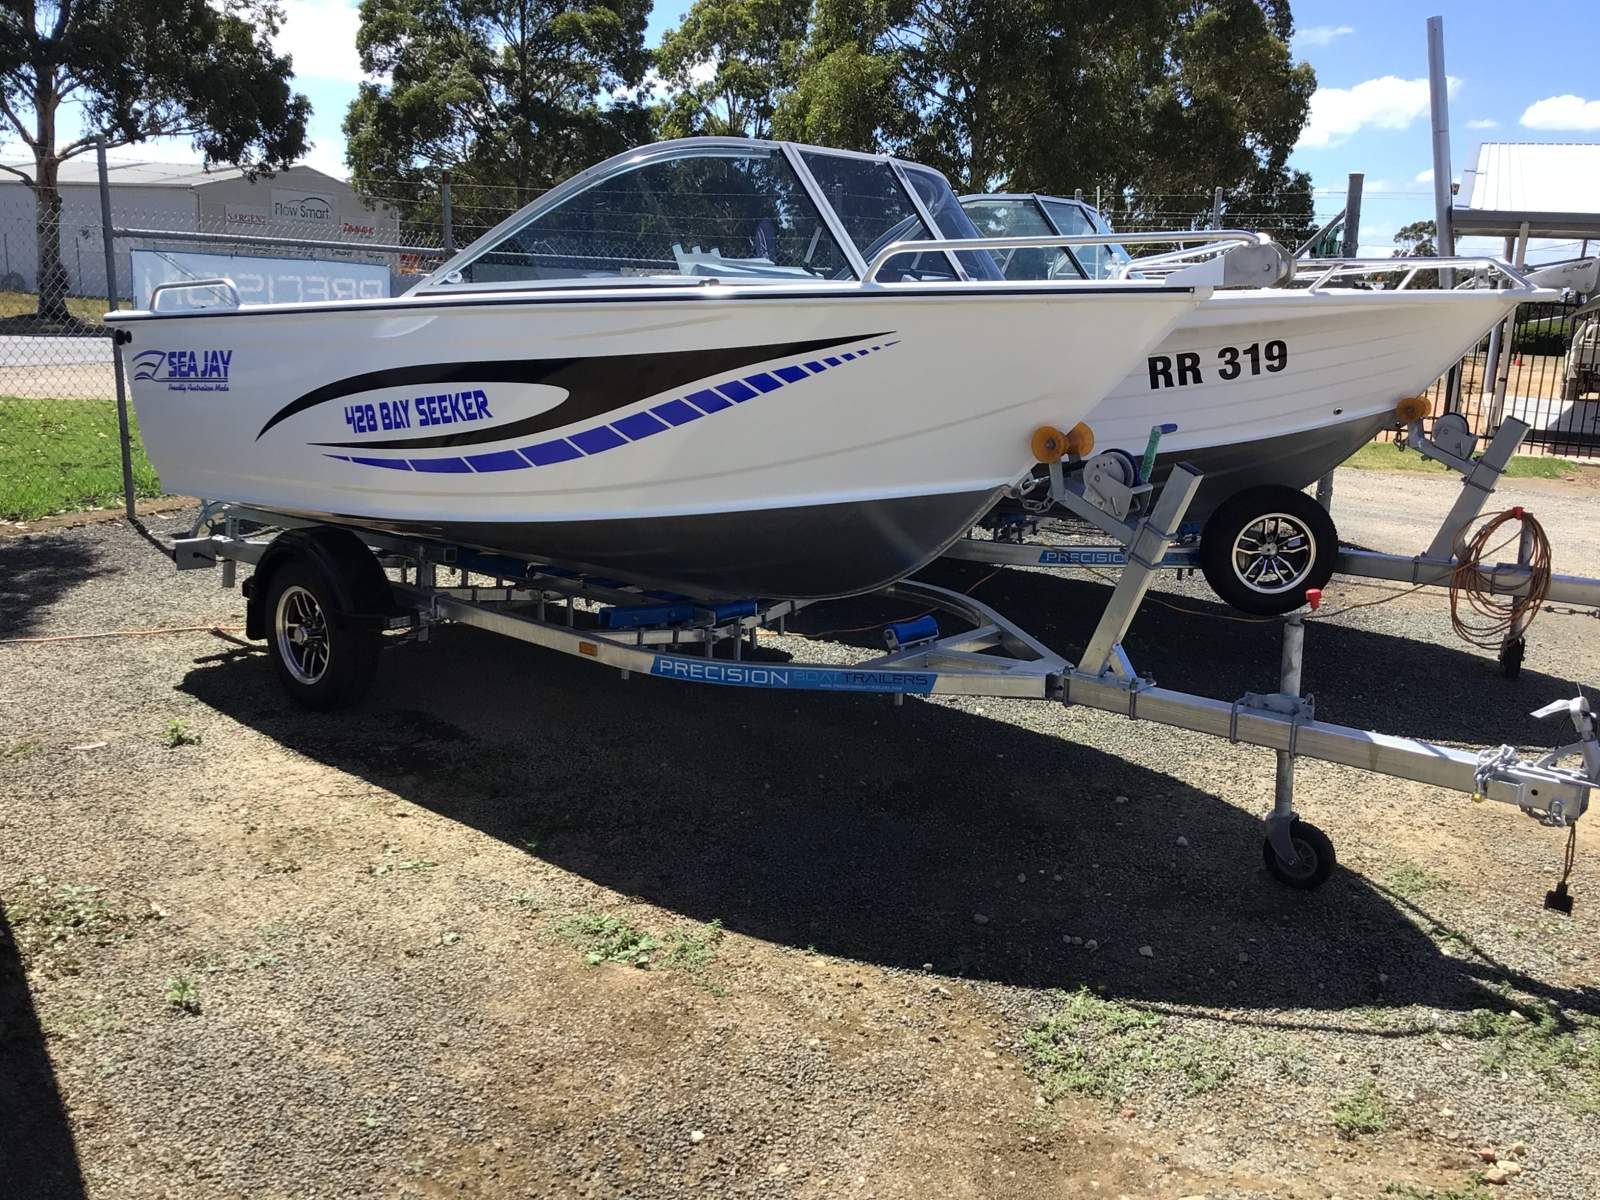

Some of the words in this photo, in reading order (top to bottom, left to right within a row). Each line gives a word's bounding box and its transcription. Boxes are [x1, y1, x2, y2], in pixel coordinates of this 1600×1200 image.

[274, 202, 298, 217] Flow
[300, 204, 330, 220] Smart
[1147, 351, 1204, 390] RR
[1217, 339, 1288, 381] 319
[344, 404, 378, 434] 428
[379, 399, 411, 431] BAY
[415, 389, 494, 427] SEEKER
[1046, 551, 1125, 564] PRECISIO
[659, 659, 789, 685] PRECISION
[793, 671, 841, 681] BOAT
[842, 672, 929, 686] TRAILERS
